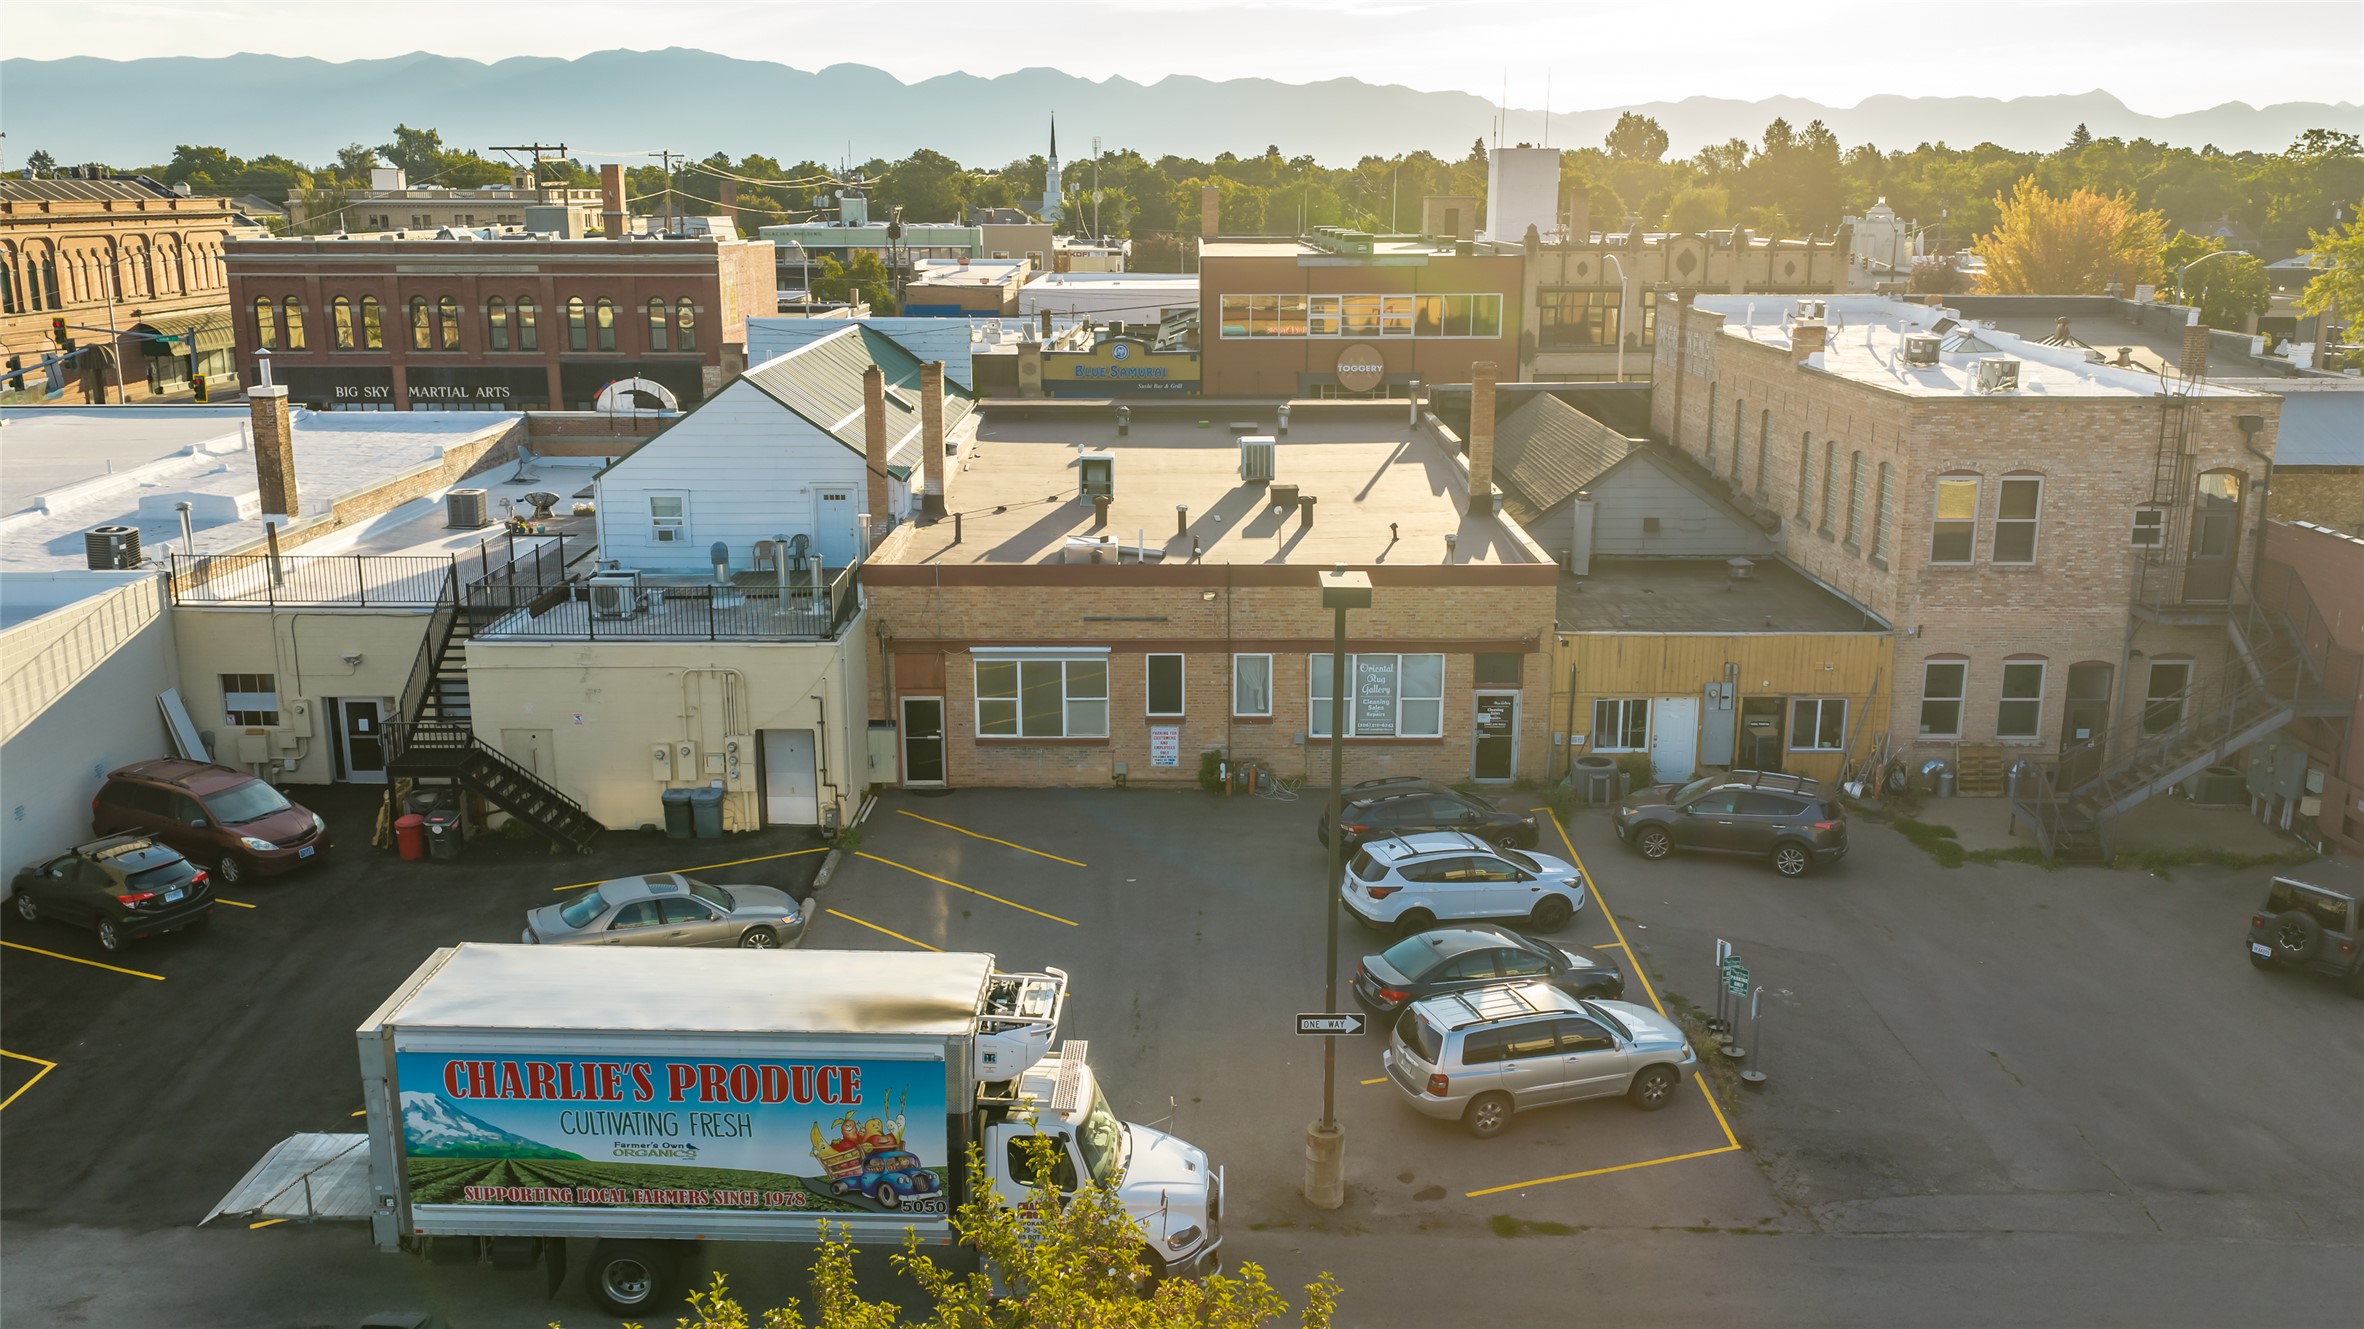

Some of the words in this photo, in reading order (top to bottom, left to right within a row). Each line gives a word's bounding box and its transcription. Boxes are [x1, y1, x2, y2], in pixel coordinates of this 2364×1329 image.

[1338, 364, 1383, 372] TOGGERY
[335, 386, 358, 398] BIG
[364, 386, 390, 398] SKY
[408, 386, 469, 398] MARTIAL
[475, 386, 510, 398] ARTS
[1359, 663, 1394, 673] Oriental
[1366, 673, 1386, 684] Rug
[1361, 684, 1391, 695] Gallery
[1730, 975, 1748, 983] PARKING
[1303, 1020, 1320, 1028] ONE
[1327, 1020, 1345, 1028] WAY
[443, 1060, 654, 1102] CHARLIE'S
[666, 1063, 862, 1105] PRODUCE
[560, 1110, 678, 1137] CULTIVATING
[690, 1112, 752, 1138] FRESH
[614, 1141, 659, 1149] Farmer's
[612, 1148, 697, 1158] ORGANICS
[464, 1186, 573, 1203] SUPPORTING
[576, 1187, 629, 1204] LOCAL
[632, 1189, 709, 1205] FARMERS
[713, 1189, 758, 1206] SINCE
[763, 1191, 807, 1206] 1978
[901, 1200, 946, 1213] 5050
